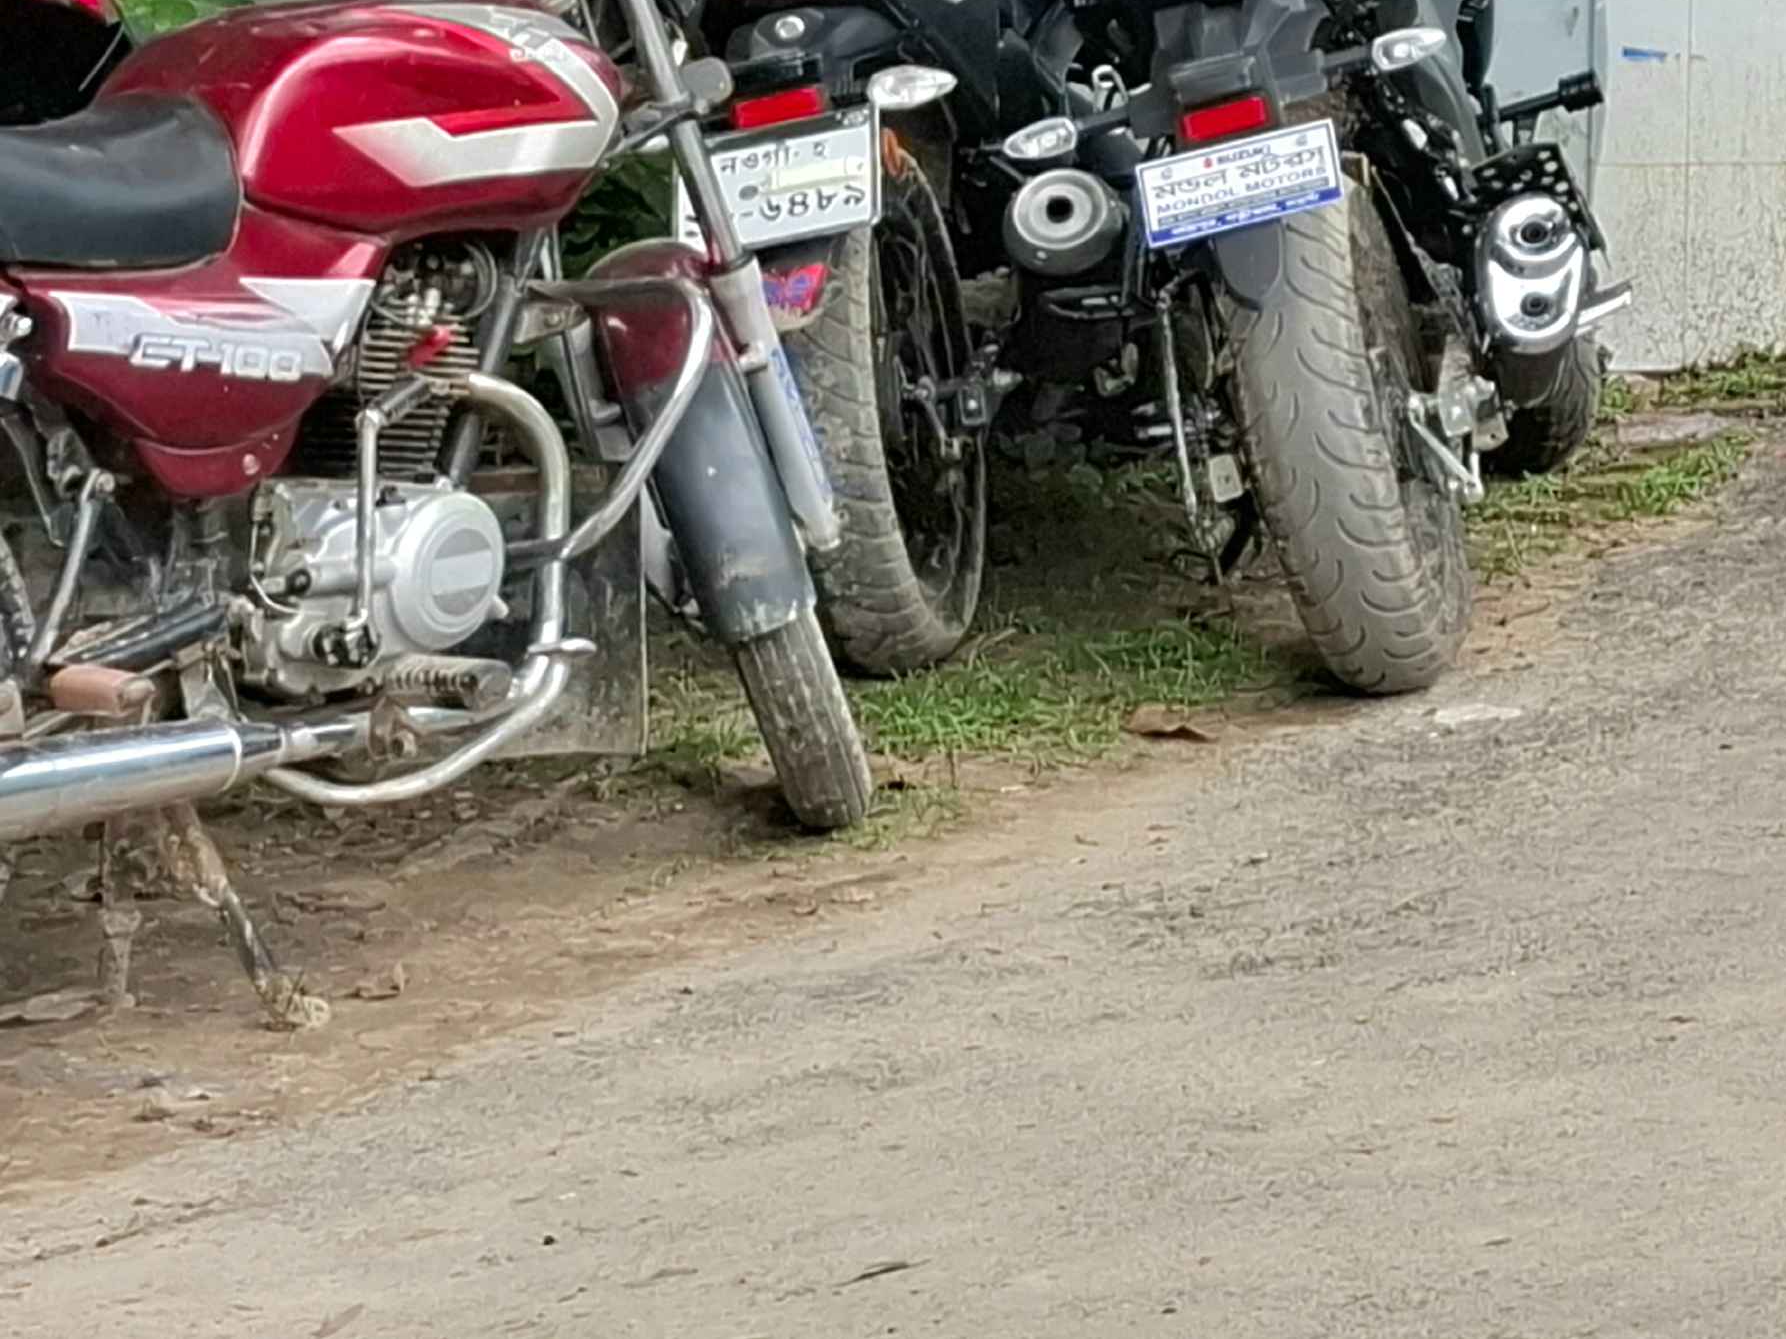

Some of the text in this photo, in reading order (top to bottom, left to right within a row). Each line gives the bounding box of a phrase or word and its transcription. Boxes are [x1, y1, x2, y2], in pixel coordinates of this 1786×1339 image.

[1157, 189, 1239, 214] MONDOL
[1245, 166, 1328, 192] MOTORS
[129, 332, 301, 381] CT-100
